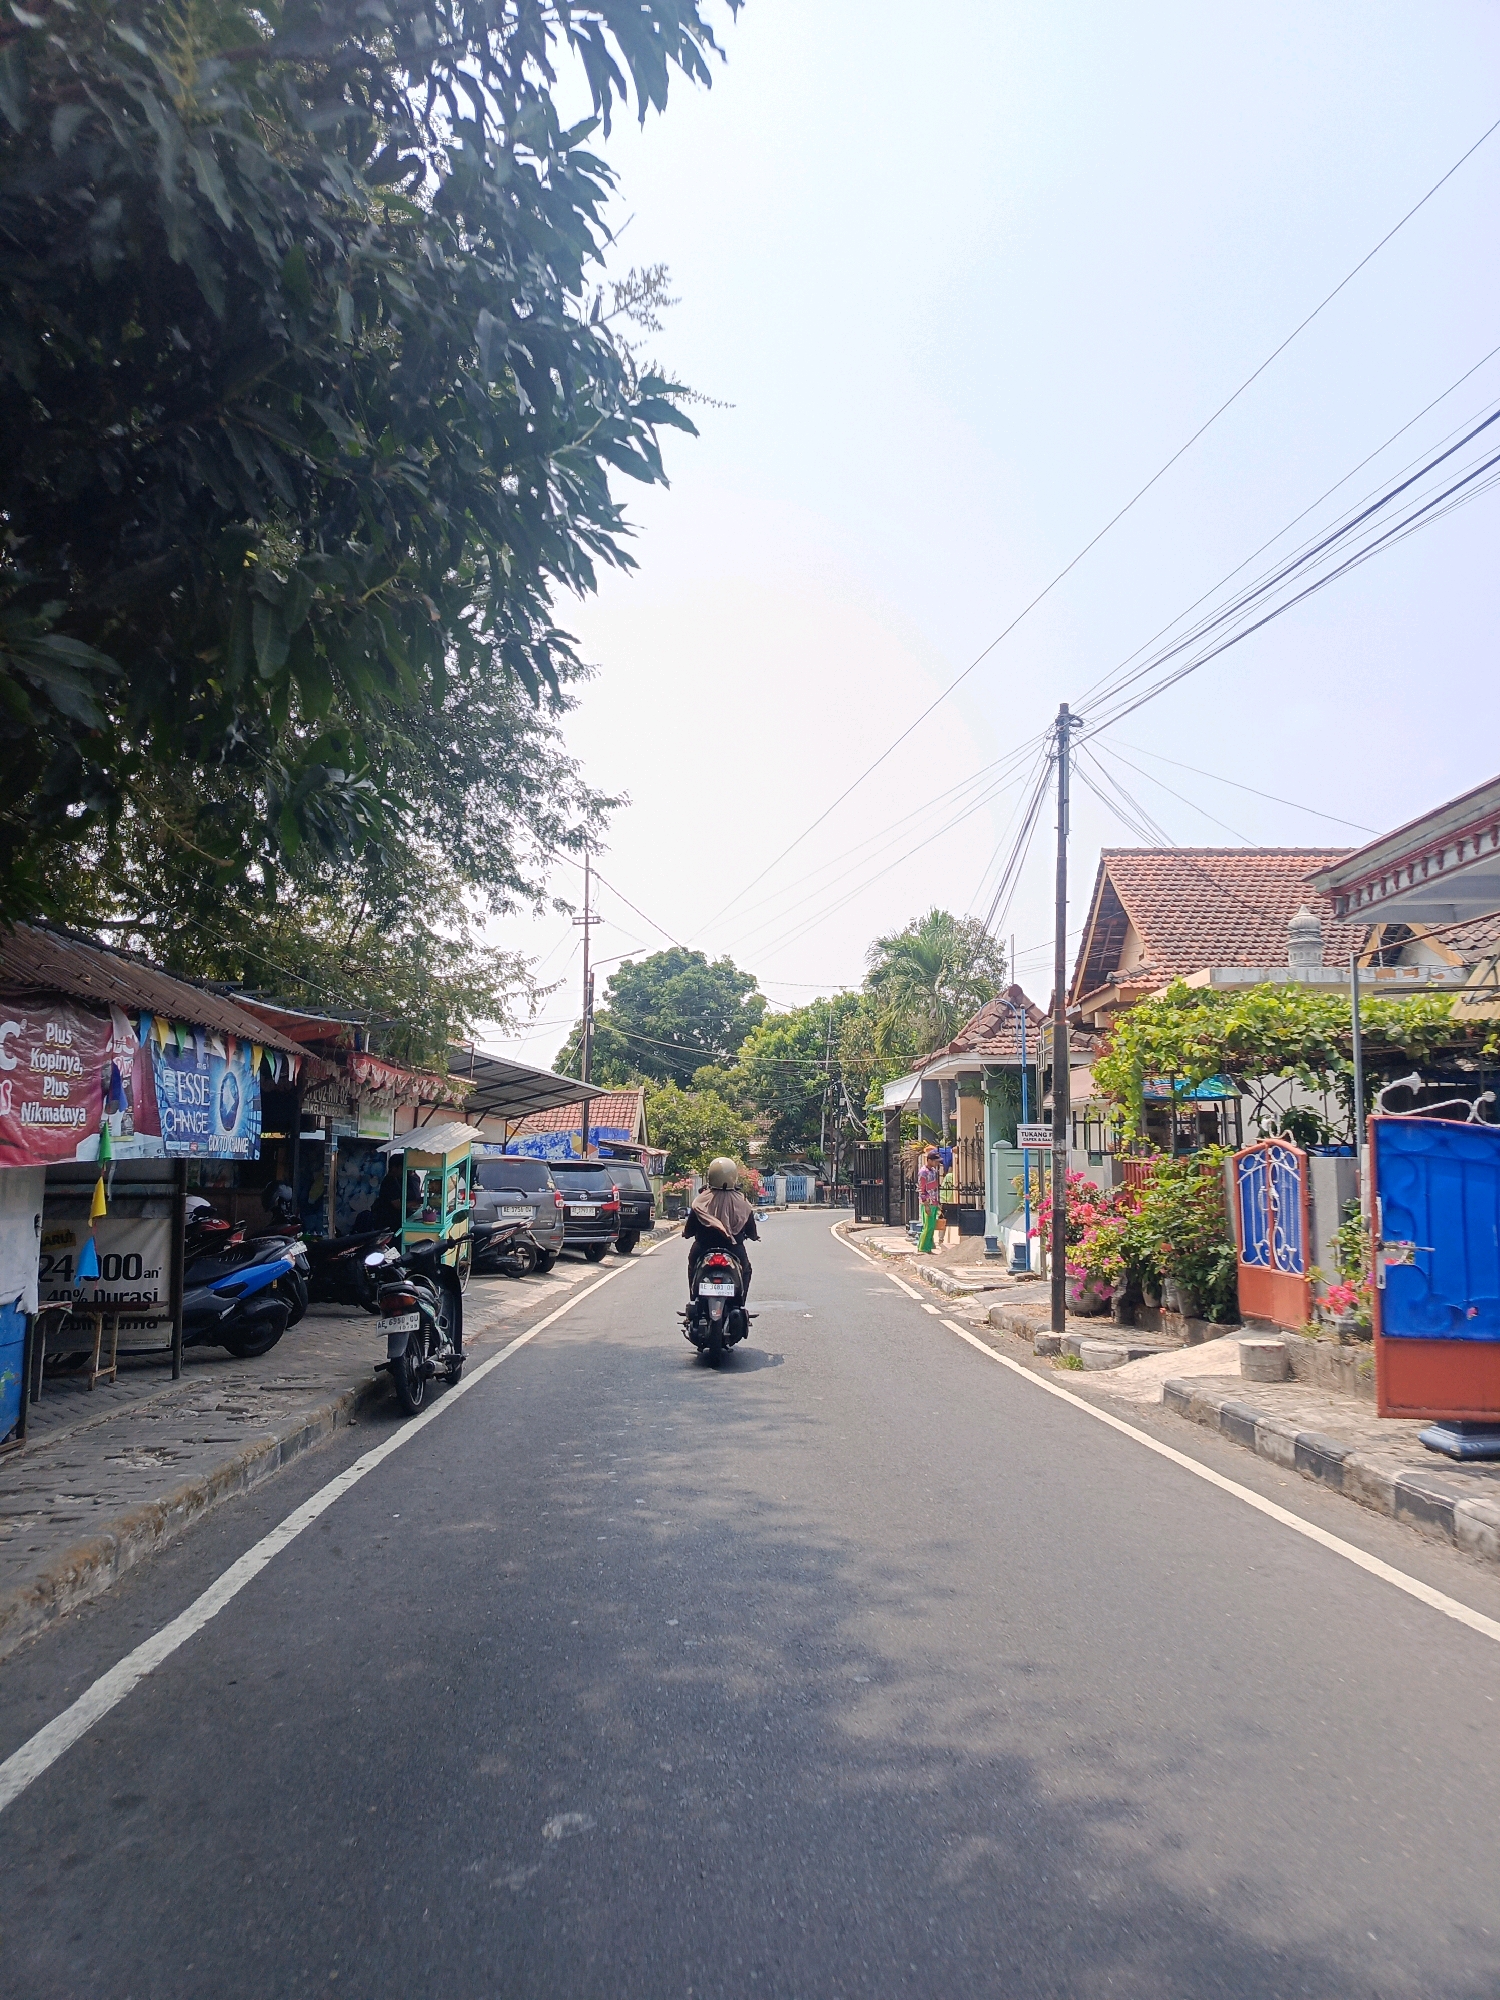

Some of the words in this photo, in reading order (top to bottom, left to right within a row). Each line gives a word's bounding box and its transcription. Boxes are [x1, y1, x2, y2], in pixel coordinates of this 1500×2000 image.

[46, 1022, 72, 1046] Plus
[30, 1047, 83, 1077] Kopinya,
[43, 1076, 69, 1099] Plus
[177, 1070, 211, 1106] ESSE
[21, 1101, 86, 1129] Nikmatnya
[164, 1107, 209, 1134] CHANGE
[42, 1230, 75, 1246] ARU!
